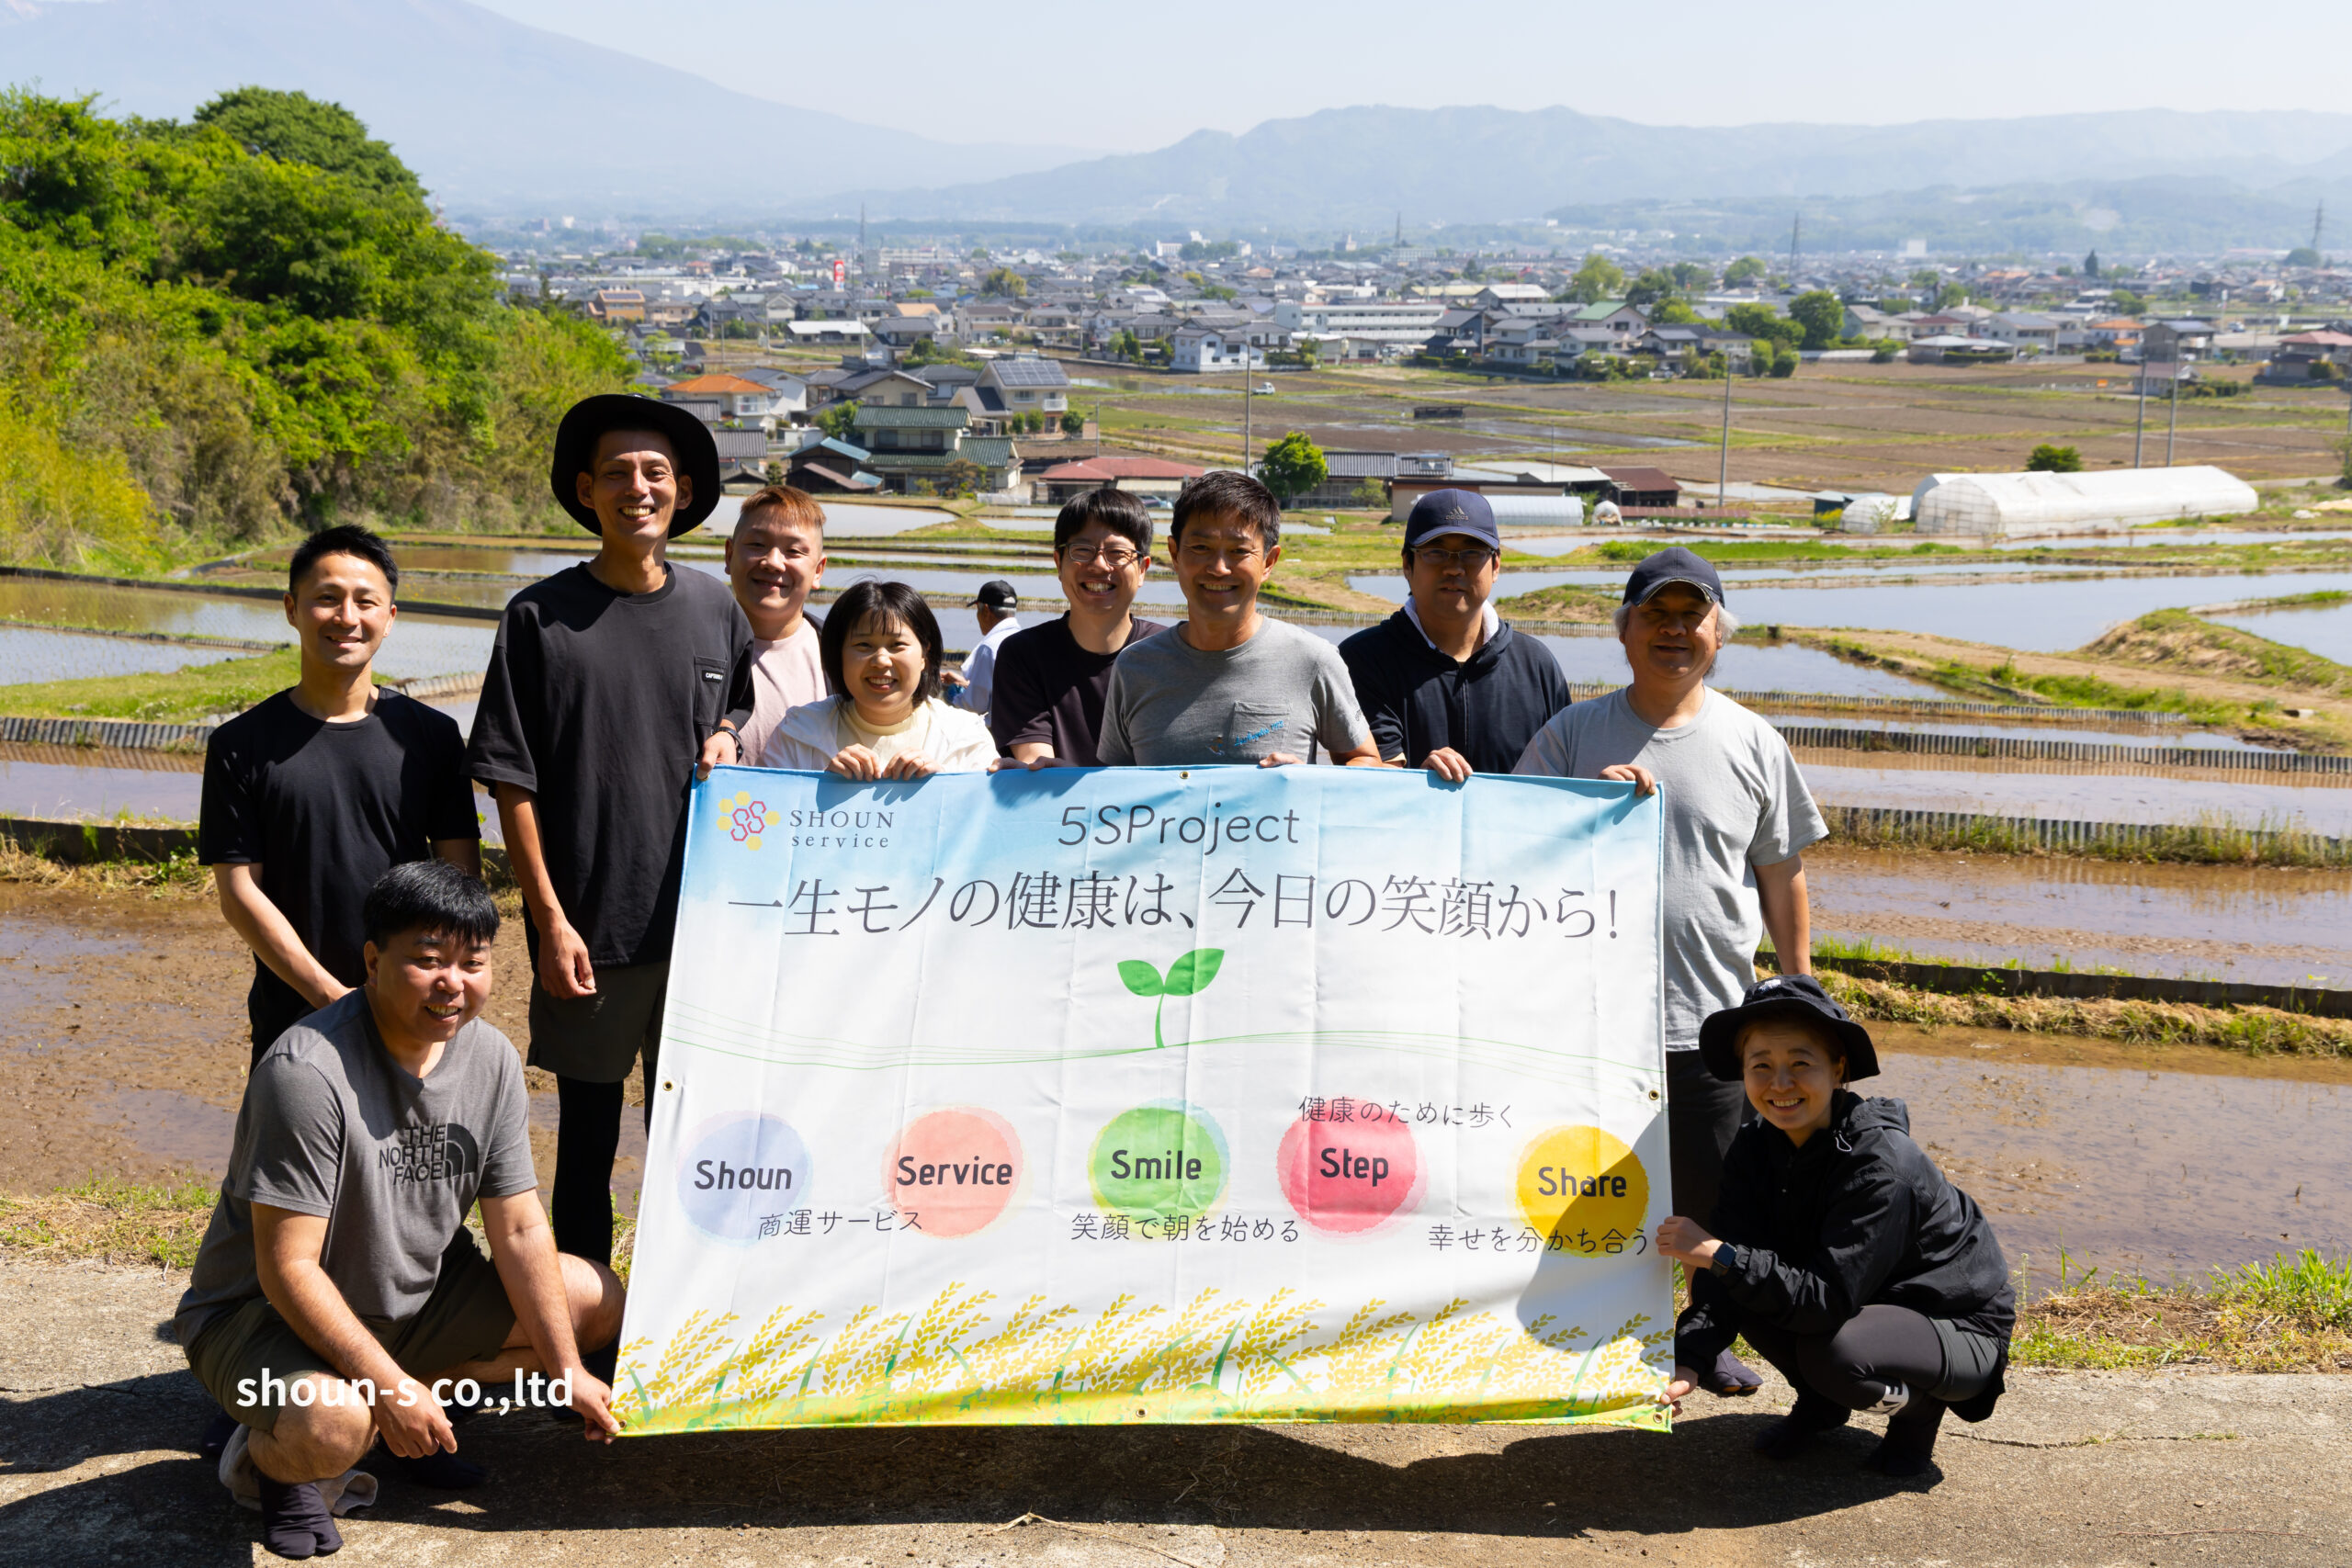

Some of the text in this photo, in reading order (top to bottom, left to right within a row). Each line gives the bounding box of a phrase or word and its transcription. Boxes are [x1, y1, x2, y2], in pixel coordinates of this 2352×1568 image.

[790, 809, 895, 829] SHOUN
[1057, 802, 1300, 856] 5SProject
[791, 833, 889, 849] service
[1298, 1095, 1513, 1130] 健康のために歩く
[405, 1124, 446, 1145] THE
[379, 1143, 446, 1168] NORTH
[896, 1155, 1012, 1187] Service
[1110, 1148, 1202, 1181] Smile
[1319, 1147, 1389, 1187] Step
[392, 1161, 443, 1186] FACE
[694, 1159, 793, 1190] Shoun
[1537, 1166, 1628, 1199] Share
[757, 1208, 923, 1240] 商運サービス
[1070, 1213, 1300, 1243] 笑顔で朝を始める
[1428, 1224, 1649, 1256] 幸せを分かち合う
